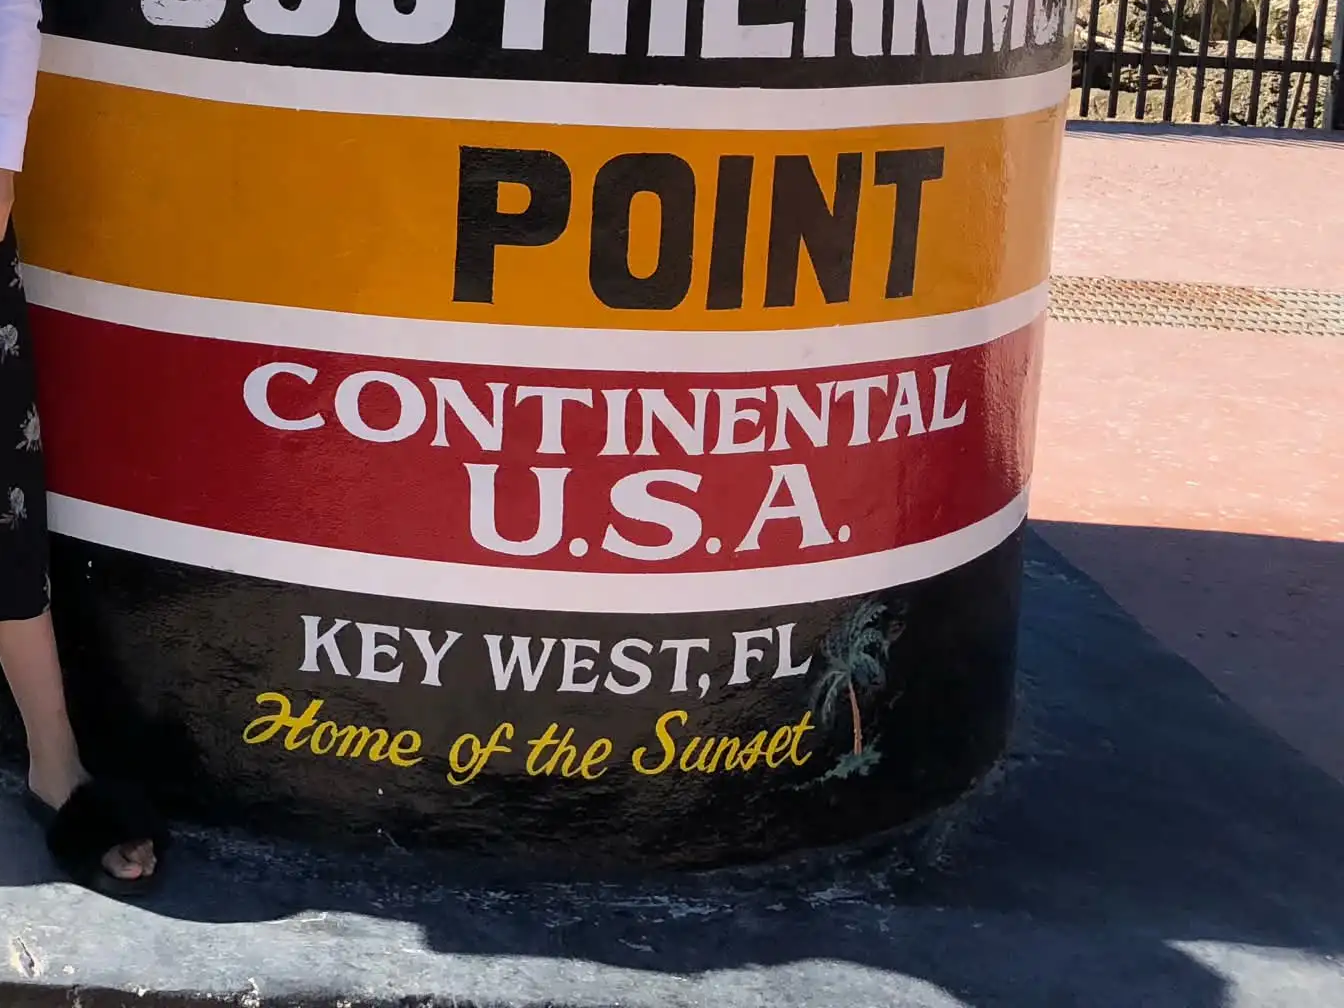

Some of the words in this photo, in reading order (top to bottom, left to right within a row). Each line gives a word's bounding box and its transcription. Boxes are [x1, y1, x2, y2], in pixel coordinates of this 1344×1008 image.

[453, 145, 945, 312] POINT
[243, 361, 968, 456] CONTINENTAL
[464, 462, 851, 561] U.S.A.
[298, 614, 463, 687] KEY
[483, 633, 710, 700] WEST,
[726, 622, 814, 687] FL
[243, 691, 423, 767] Home
[447, 722, 516, 786] of
[526, 728, 609, 780] the
[633, 709, 816, 776] Sunset
